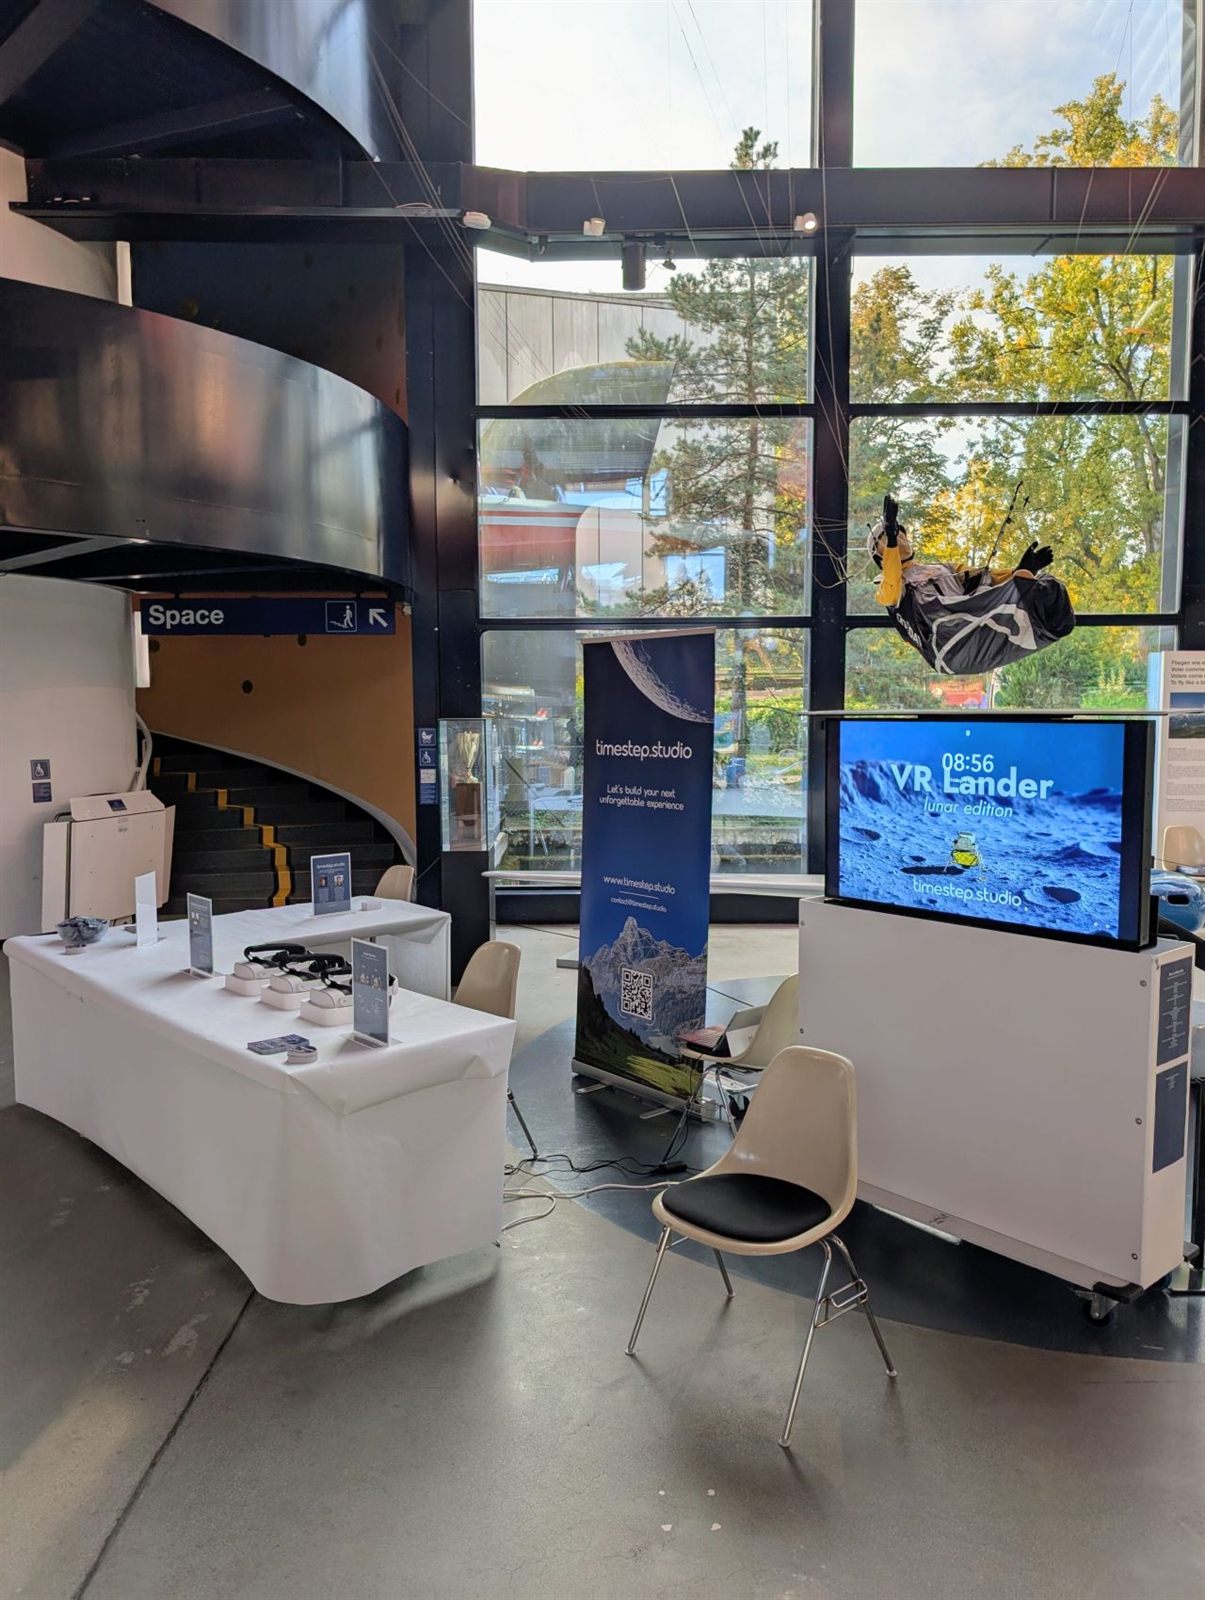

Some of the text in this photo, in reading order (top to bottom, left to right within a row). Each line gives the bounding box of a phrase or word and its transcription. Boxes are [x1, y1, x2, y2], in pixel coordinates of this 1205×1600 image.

[149, 604, 224, 629] Space
[596, 739, 693, 761] timestep.studio
[942, 753, 994, 773] 08:56
[607, 784, 676, 798] Let's build your next
[891, 764, 1054, 799] VR Lander
[600, 795, 684, 811] unforgettable experience
[924, 797, 1013, 818] lunar edition
[603, 875, 676, 895] www.timestep.studio
[913, 879, 1022, 906] timestep.studio
